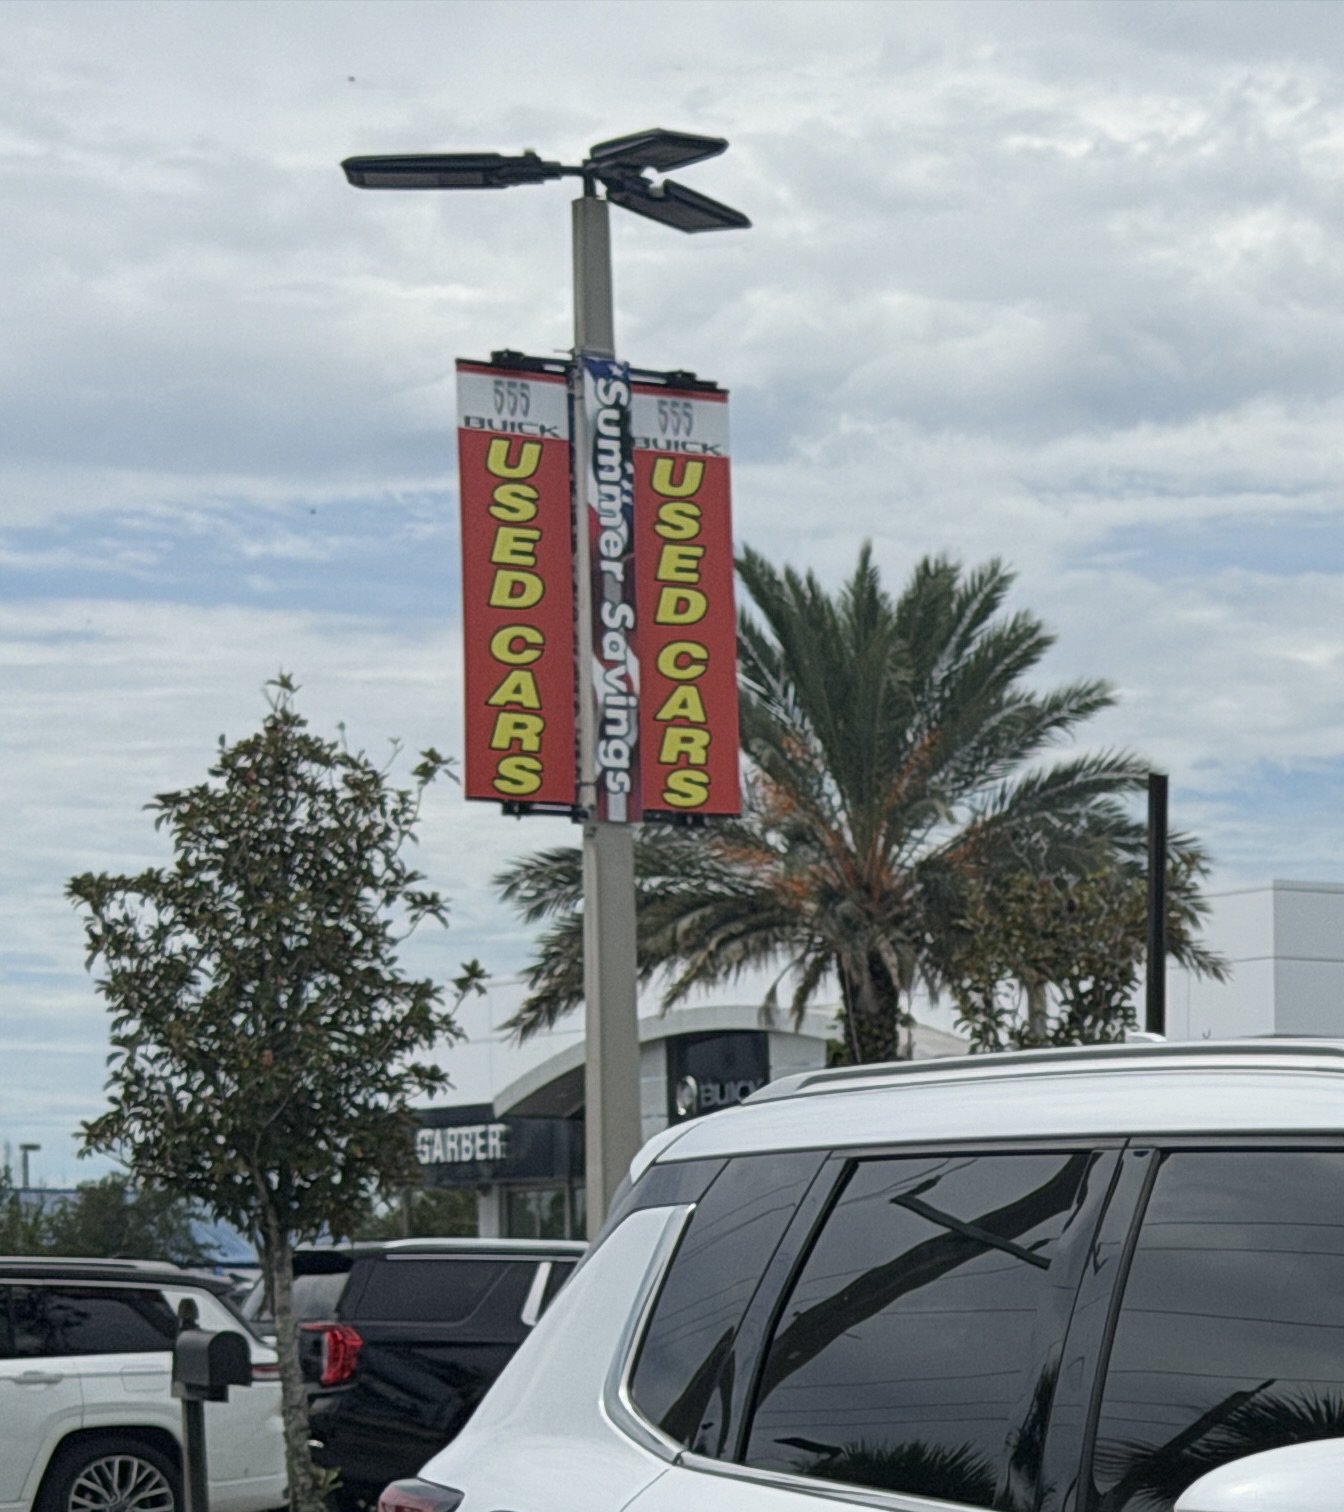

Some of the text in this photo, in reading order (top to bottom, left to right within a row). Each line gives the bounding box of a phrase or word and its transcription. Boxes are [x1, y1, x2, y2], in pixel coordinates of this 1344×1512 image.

[464, 415, 560, 439] BUICK
[597, 378, 637, 793] Summer Savings
[632, 436, 722, 456] BUICK
[485, 438, 545, 797] USED CARS
[650, 457, 712, 809] USED CARS
